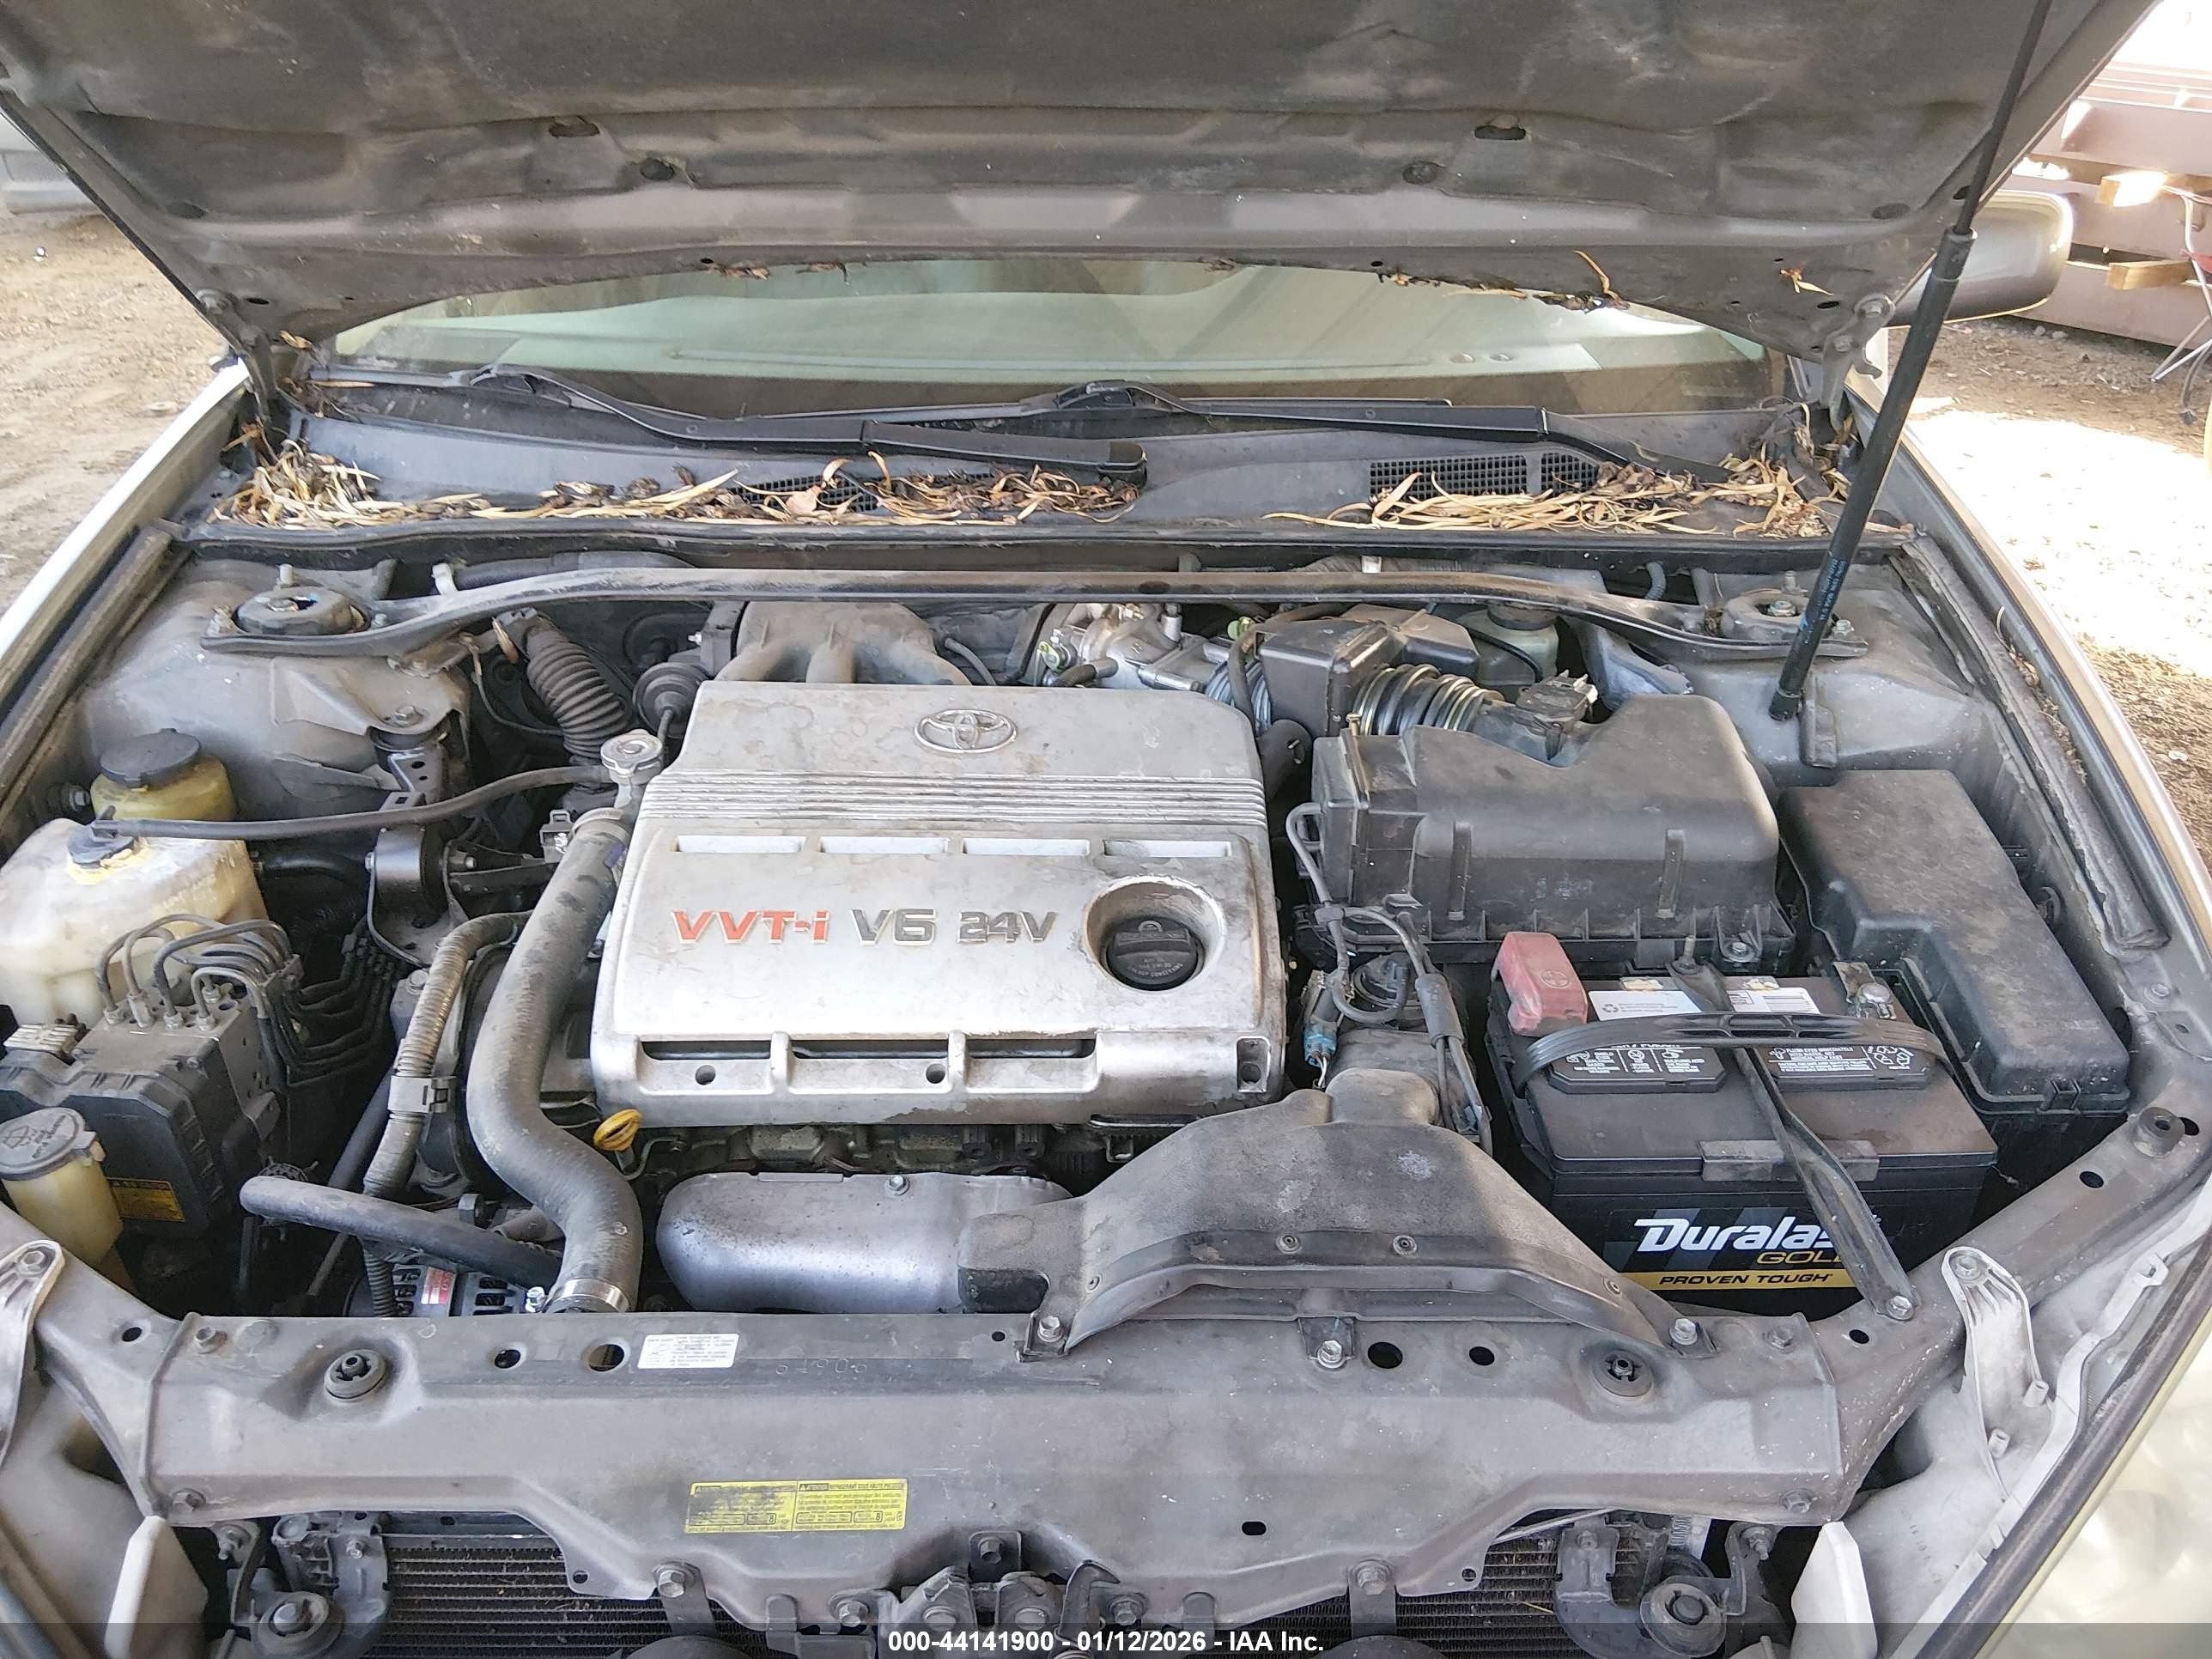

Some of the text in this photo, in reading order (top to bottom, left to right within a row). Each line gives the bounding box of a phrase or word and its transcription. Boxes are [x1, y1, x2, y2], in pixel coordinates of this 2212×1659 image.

[671, 908, 1059, 946] VVT-i V6 24V
[1634, 1216, 1835, 1252] Durala
[1659, 1273, 1829, 1285] PROVEN TOUGH
